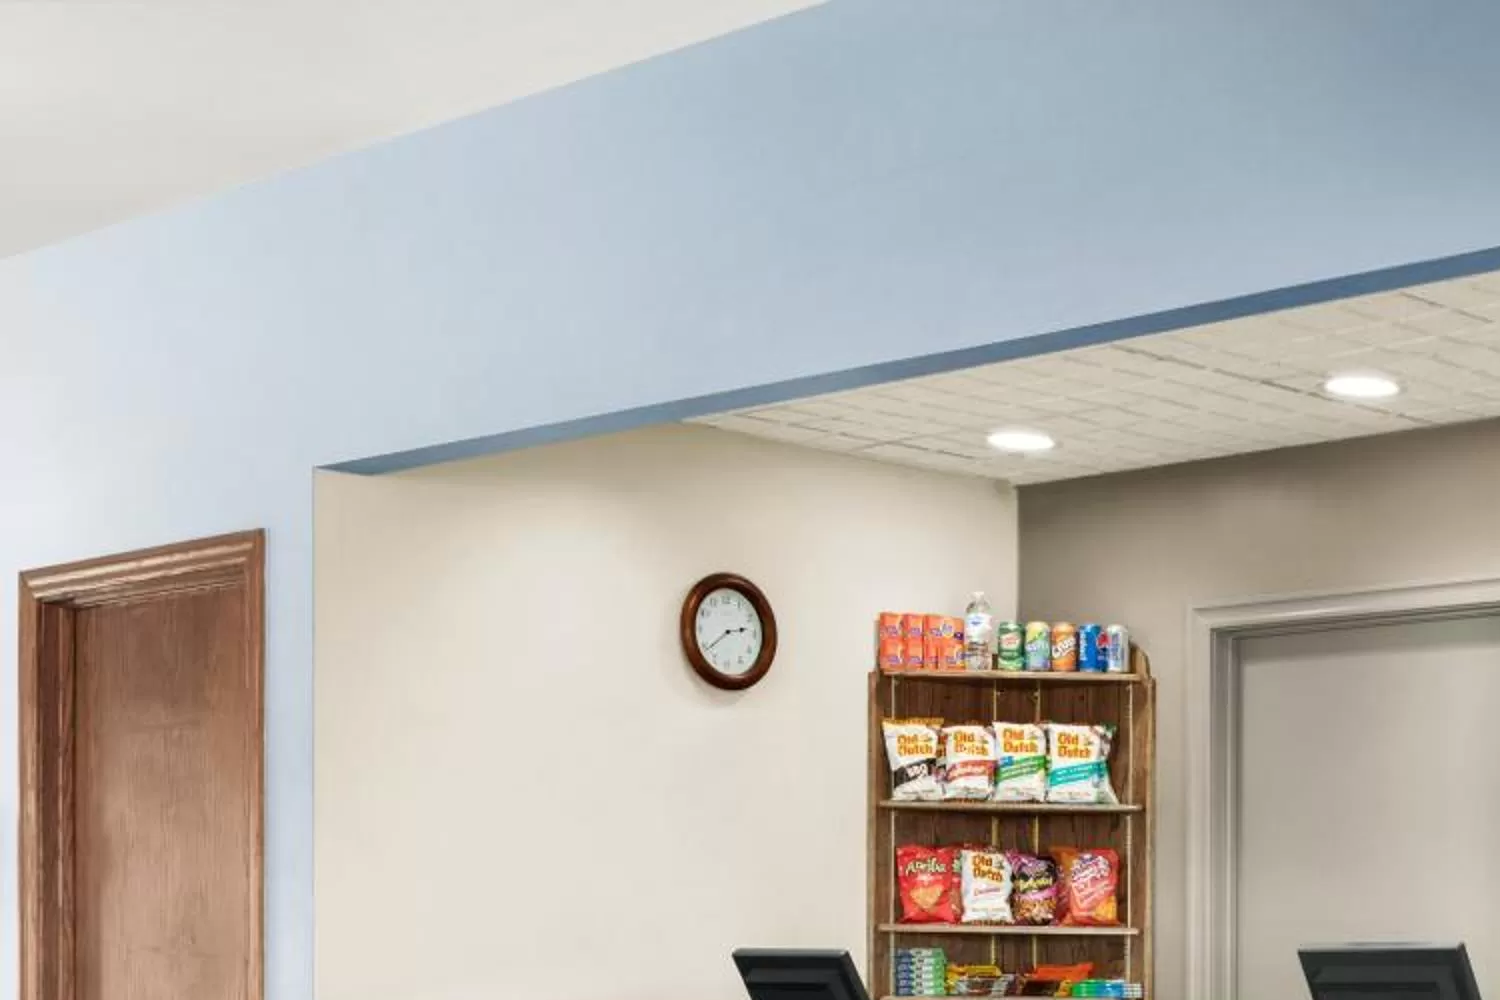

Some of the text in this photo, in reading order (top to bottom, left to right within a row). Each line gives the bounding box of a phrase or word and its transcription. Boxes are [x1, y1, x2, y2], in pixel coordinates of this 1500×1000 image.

[897, 734, 918, 744] Old
[953, 731, 975, 742] Old
[1003, 728, 1025, 740] Old
[1057, 732, 1079, 745] Old
[897, 744, 933, 757] Dutch
[953, 742, 989, 756] Dutch
[1003, 740, 1038, 753] Dutch
[1057, 745, 1090, 758] Dutch
[973, 855, 992, 867] Old
[973, 866, 1003, 882] Dutch
